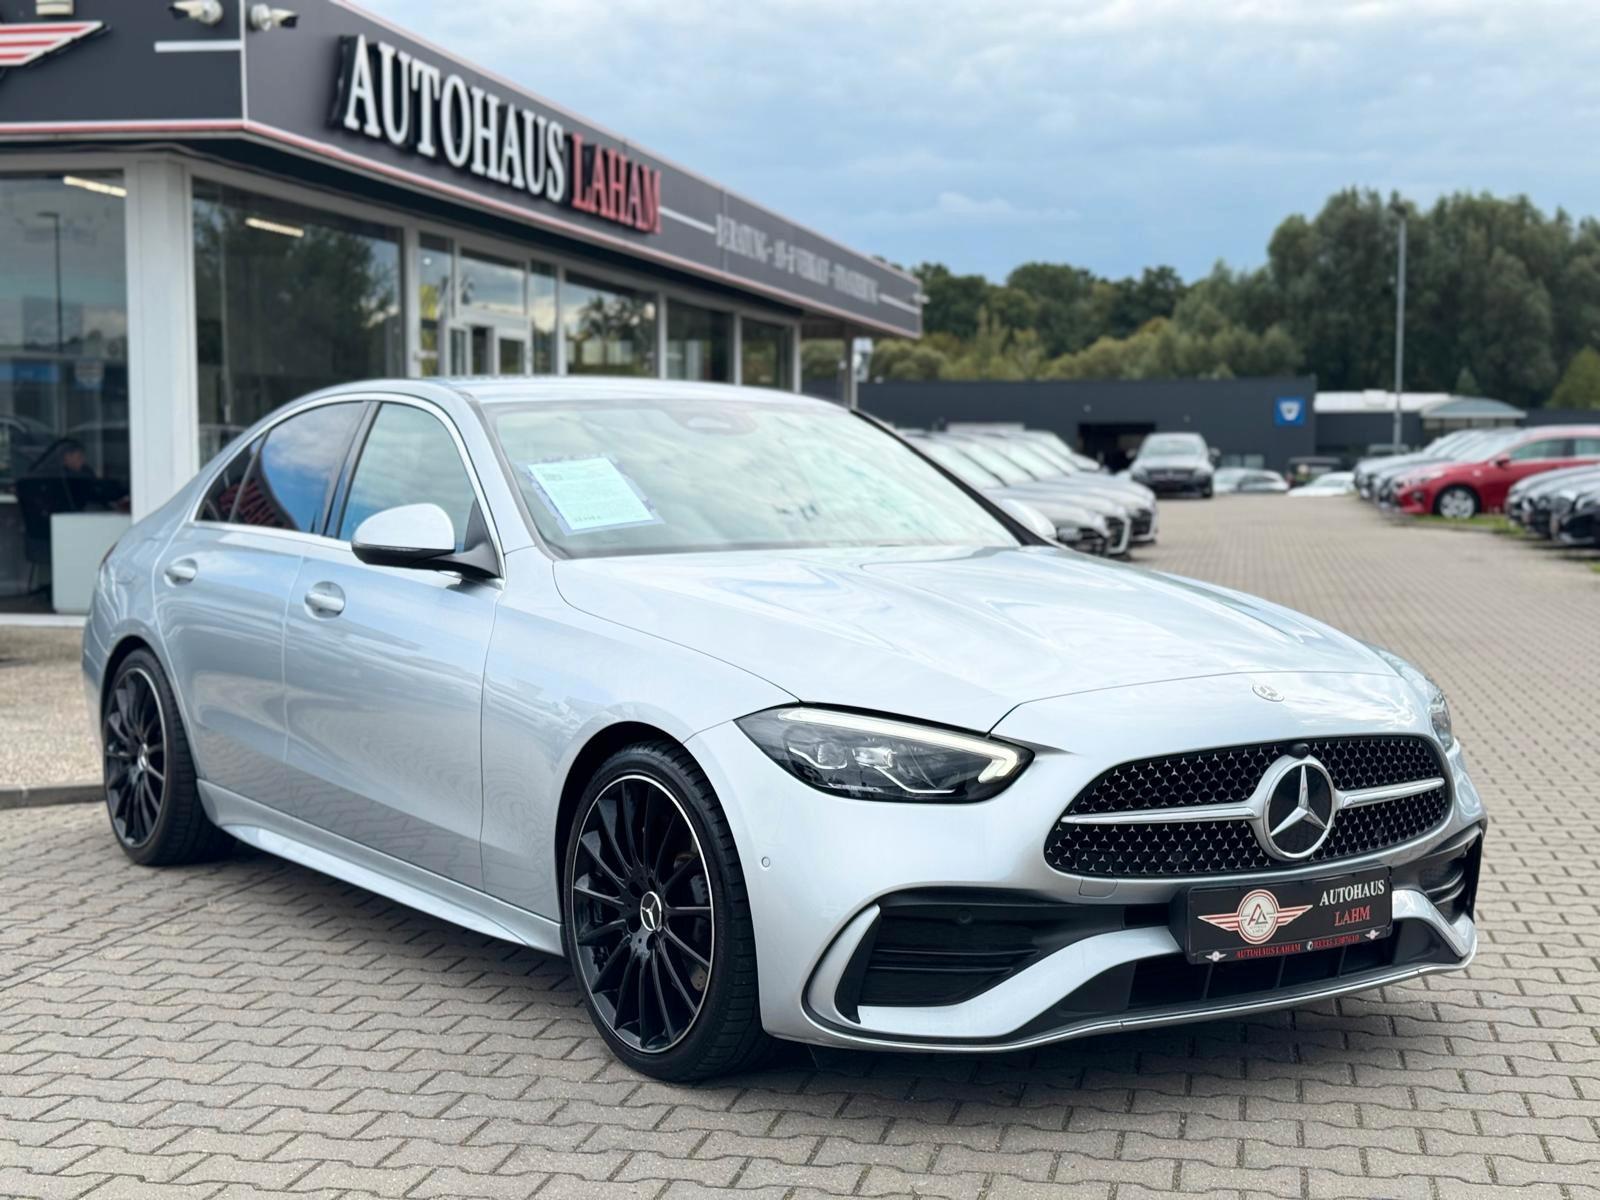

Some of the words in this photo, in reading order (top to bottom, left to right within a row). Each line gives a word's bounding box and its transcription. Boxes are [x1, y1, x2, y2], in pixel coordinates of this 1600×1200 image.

[343, 34, 566, 203] AUTOHAUS
[571, 133, 662, 234] LAHAM
[1319, 880, 1385, 907] AUTOHAUS
[1334, 905, 1371, 927] LAHM
[1236, 946, 1275, 959] AUTOHAUS
